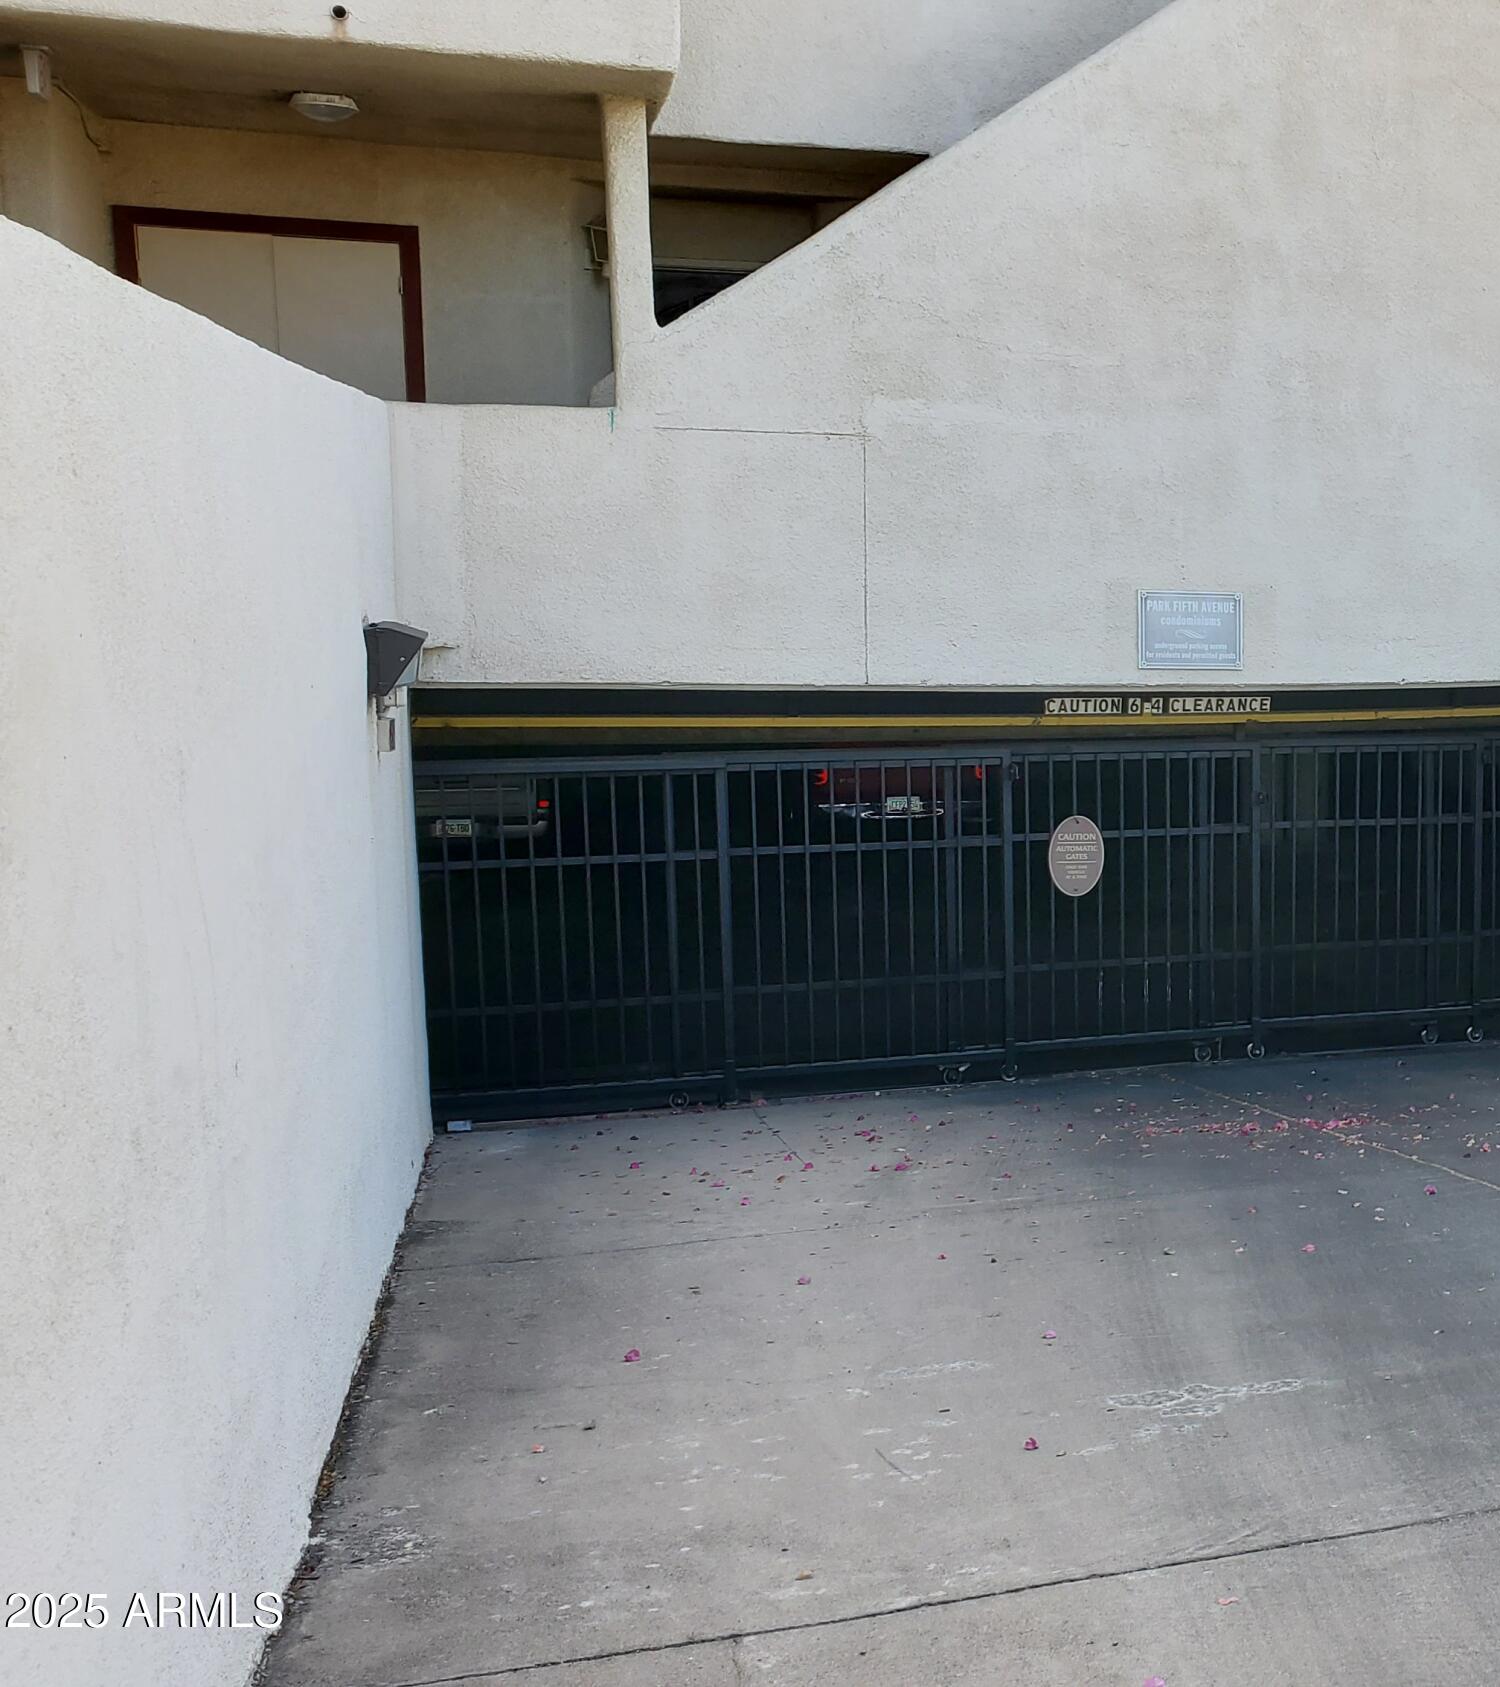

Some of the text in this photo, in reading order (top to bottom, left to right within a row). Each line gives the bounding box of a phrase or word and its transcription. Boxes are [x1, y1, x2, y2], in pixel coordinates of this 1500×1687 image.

[1146, 600, 1235, 613] PARK FIFTH AVENUE
[1160, 615, 1221, 626] condominiums
[1046, 699, 1121, 713] CAUTION
[1170, 698, 1270, 712] CLEARANCE
[1057, 832, 1096, 841] CAUTION
